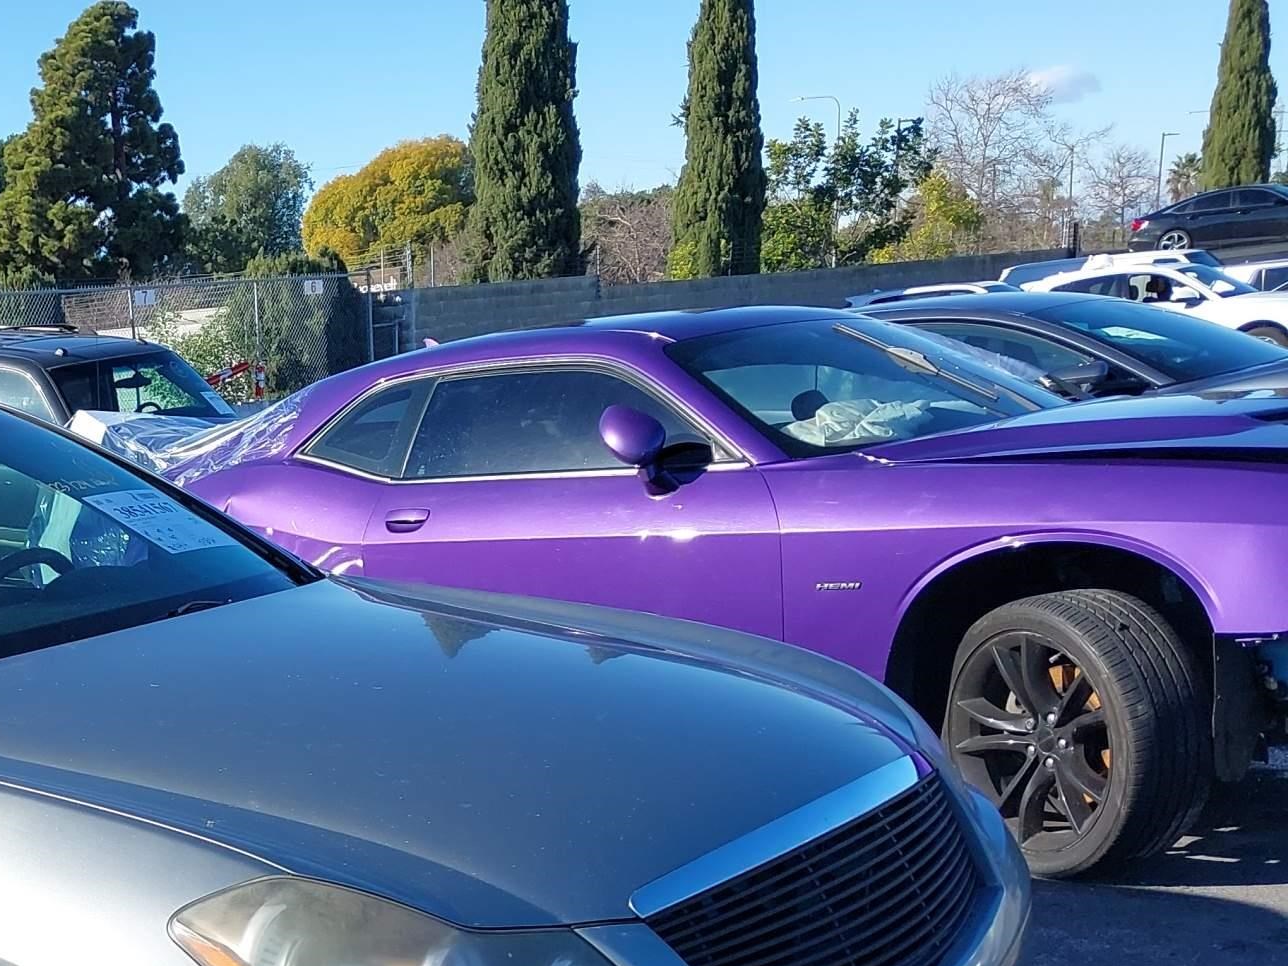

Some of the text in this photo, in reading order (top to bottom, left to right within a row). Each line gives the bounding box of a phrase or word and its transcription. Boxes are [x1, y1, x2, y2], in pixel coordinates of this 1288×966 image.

[310, 281, 317, 294] 6
[141, 290, 148, 305] 7
[113, 502, 180, 520] 38541567
[815, 581, 863, 591] HEMI
